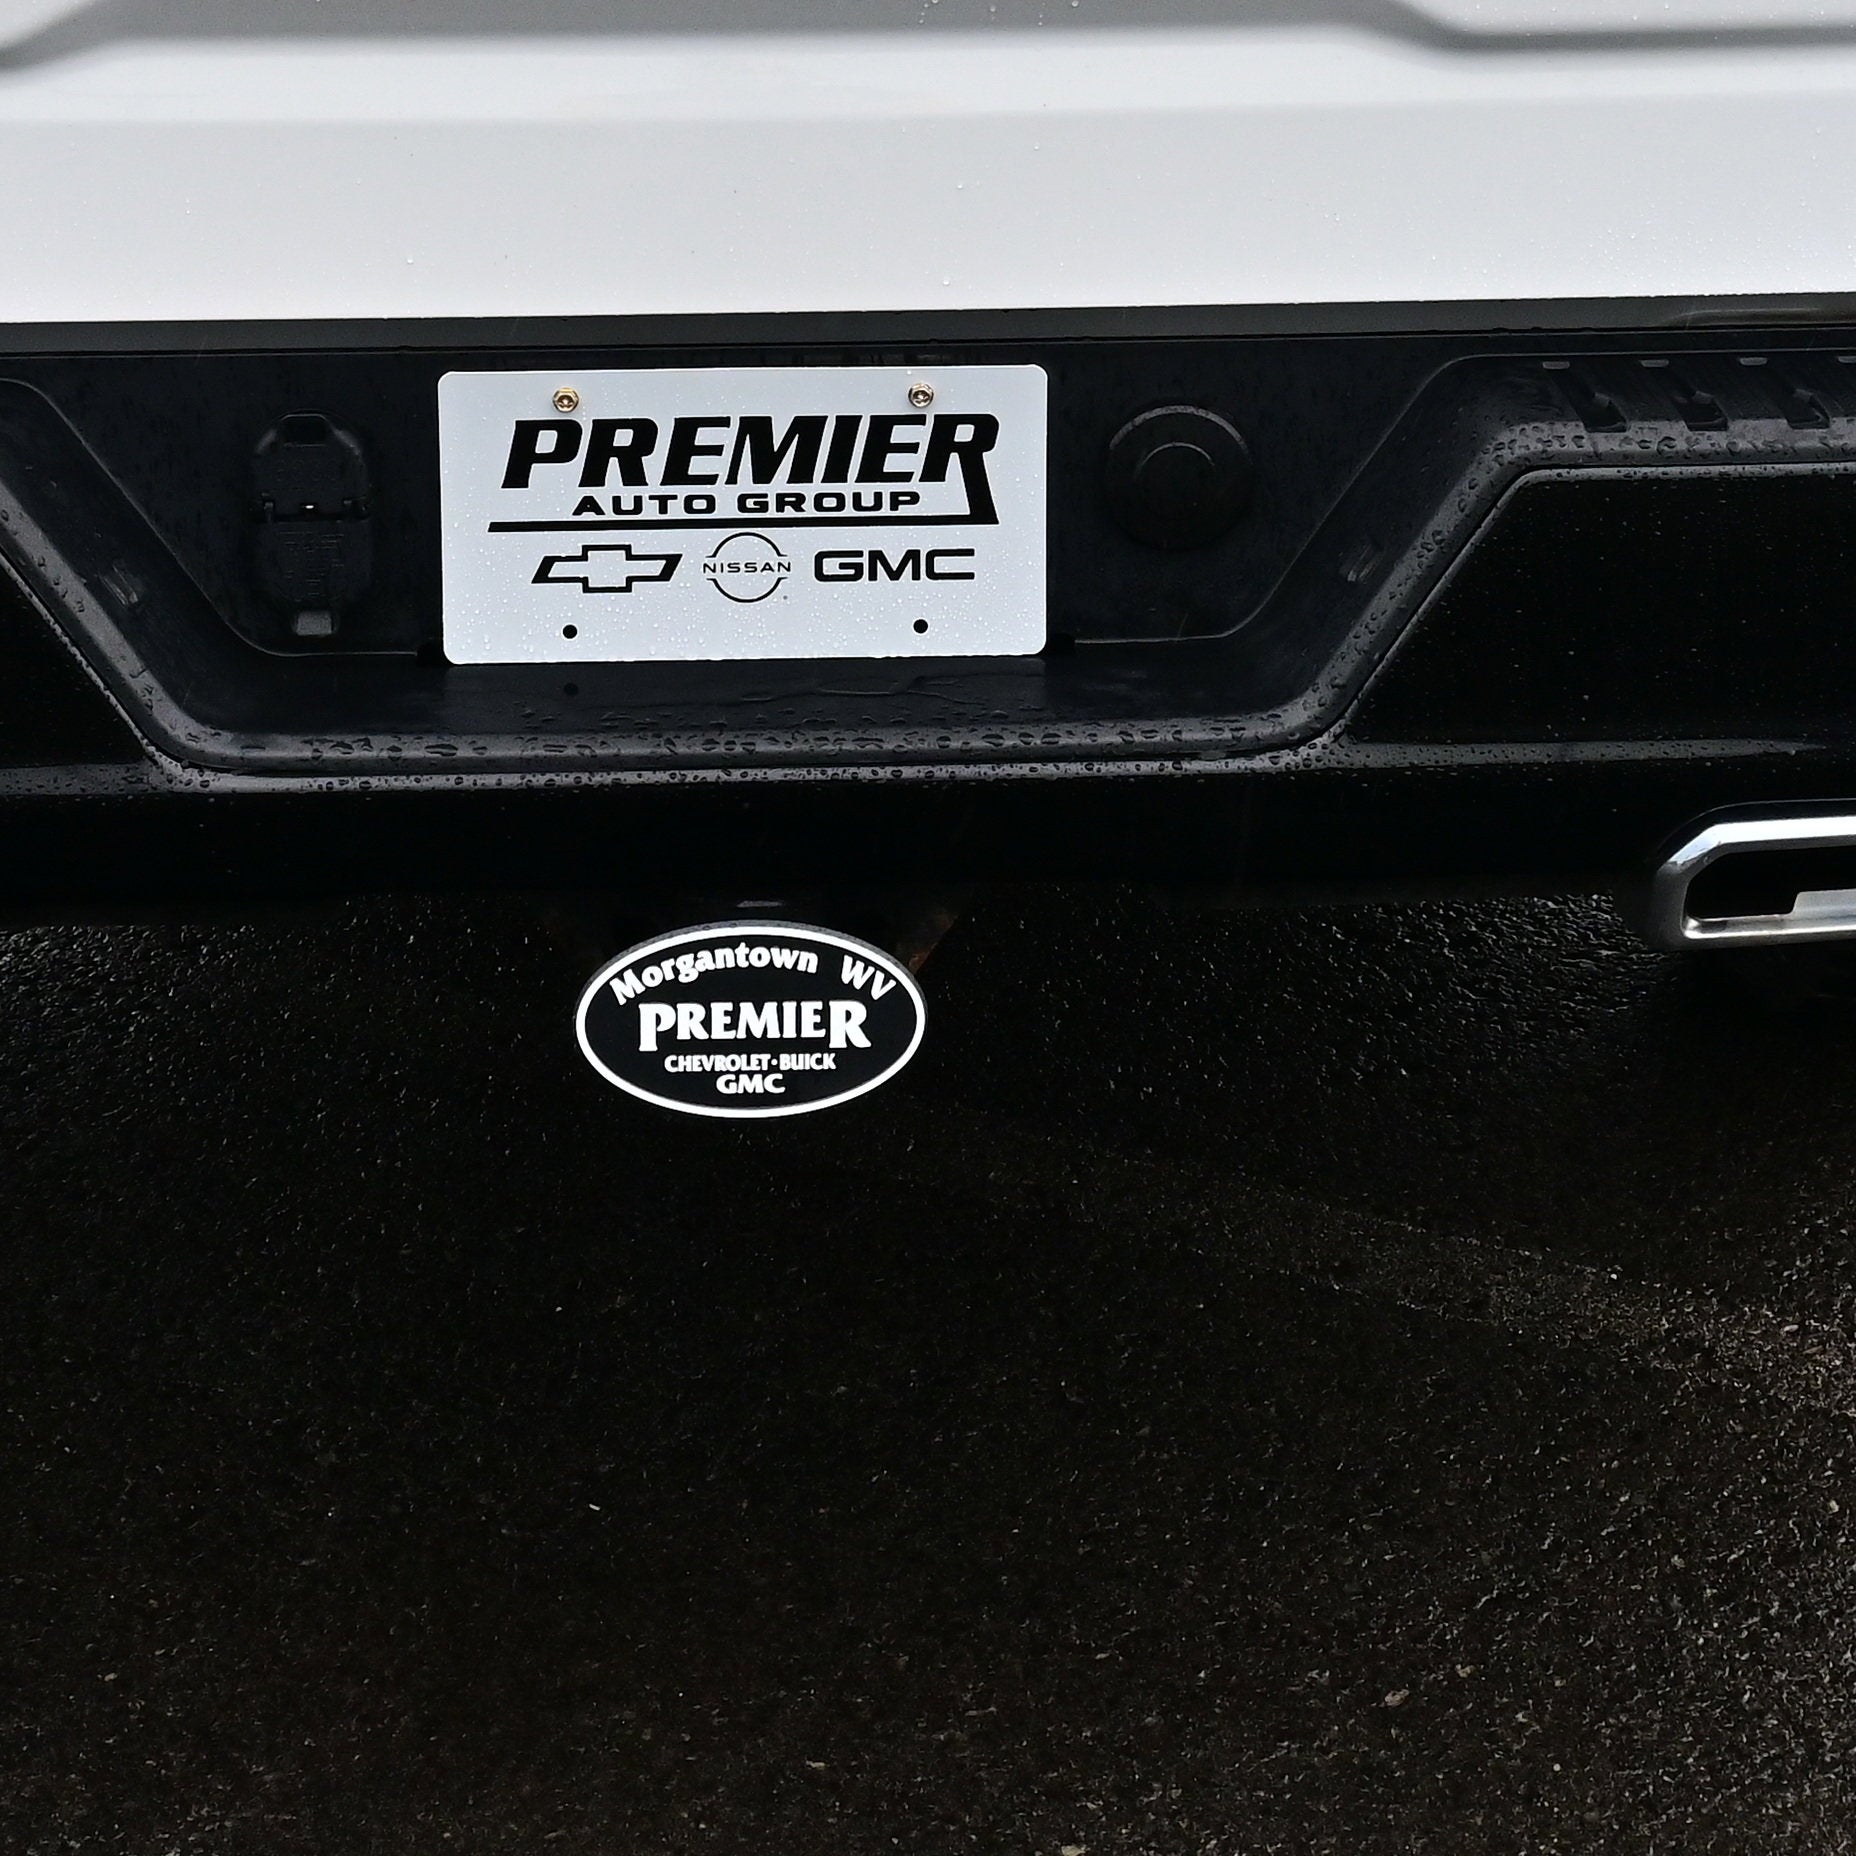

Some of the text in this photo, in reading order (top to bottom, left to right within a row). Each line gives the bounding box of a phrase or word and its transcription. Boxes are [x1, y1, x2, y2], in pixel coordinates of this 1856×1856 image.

[501, 413, 1000, 525] PREMIER
[572, 490, 921, 516] AUTO GROUP
[703, 561, 791, 574] NISSAN
[813, 548, 976, 582] GMC
[609, 941, 897, 1006] Morgantown WV
[638, 999, 872, 1052] PREMIER
[716, 1073, 786, 1094] GMC
